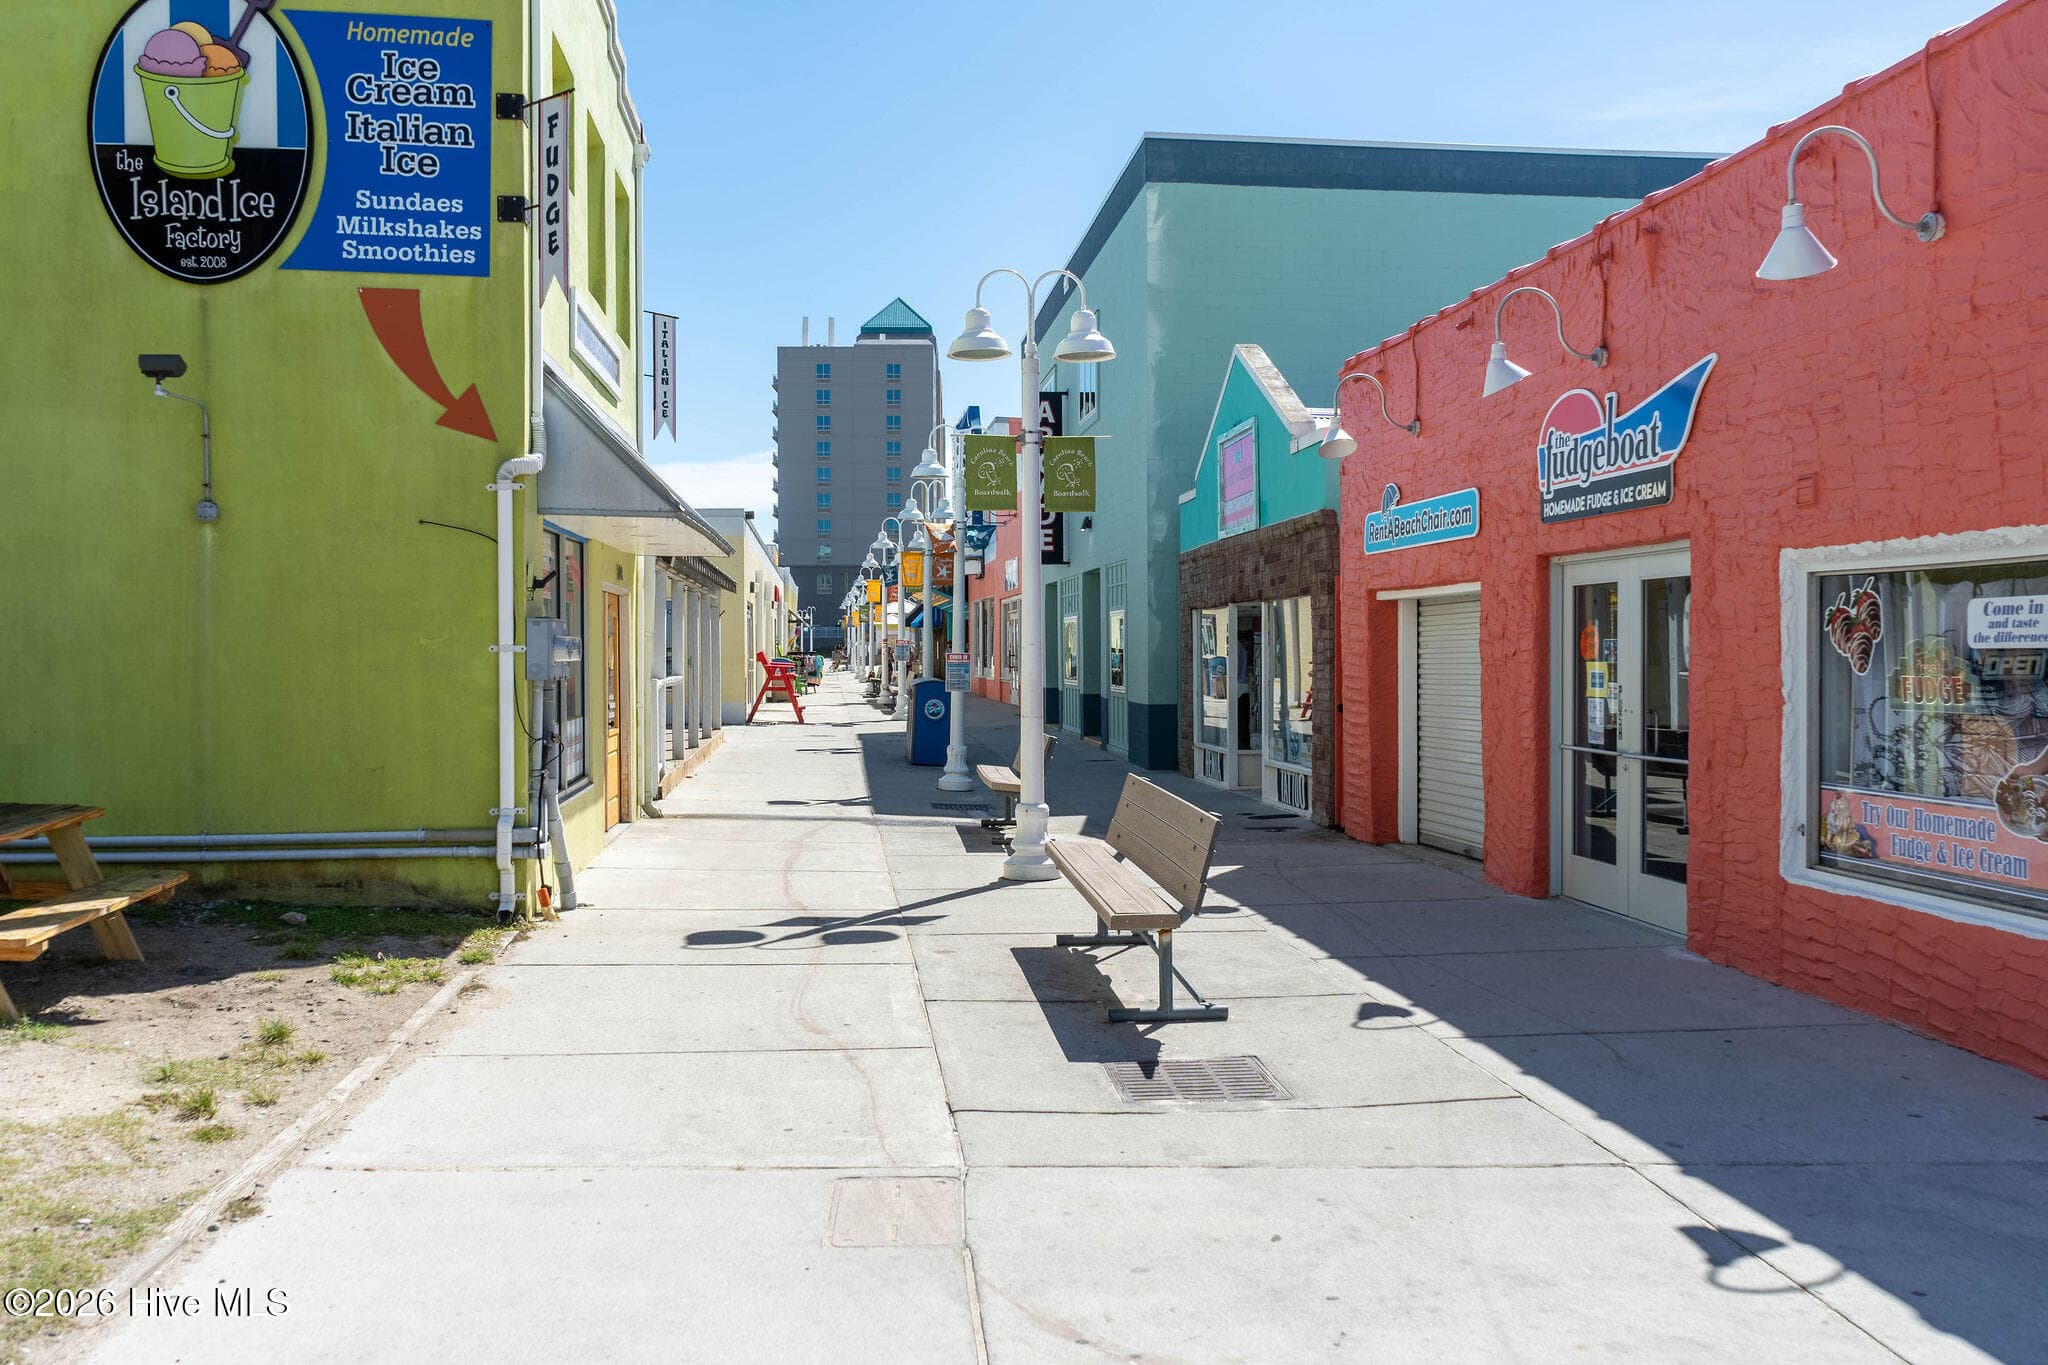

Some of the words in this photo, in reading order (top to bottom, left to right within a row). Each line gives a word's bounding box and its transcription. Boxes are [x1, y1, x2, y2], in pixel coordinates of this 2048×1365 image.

[347, 21, 475, 48] Homemade
[381, 50, 440, 82] Ice
[346, 73, 476, 109] Cream
[345, 111, 475, 148] Italian
[115, 150, 144, 172] the
[380, 144, 440, 178] Ice
[545, 112, 559, 256] FUDGE
[130, 176, 227, 222] Island
[229, 178, 276, 223] Ice
[355, 189, 464, 213] Sundaes
[165, 222, 242, 254] Factory
[336, 214, 482, 241] Milkshakes
[200, 256, 227, 268] 2008
[342, 239, 476, 264] Smoothies
[661, 321, 670, 386] ITALIAN
[661, 390, 669, 418] ICE
[1544, 397, 1661, 496] fudgeboat
[1555, 430, 1571, 449] the
[970, 447, 997, 465] Carolina
[1049, 448, 1075, 466] Carolina
[974, 488, 1012, 496] Boardwalk
[1053, 489, 1090, 497] Boardwalk
[1543, 495, 1586, 518] HOMEMADE
[1586, 490, 1612, 510] FUDGE
[1613, 489, 1620, 506] &
[1620, 486, 1634, 503] ICE
[1635, 480, 1667, 500] CREAM
[1368, 505, 1473, 544] RentABeachChair.com
[1983, 601, 2024, 616] Come
[2028, 599, 2044, 615] in
[1988, 617, 2009, 629] and
[2012, 618, 2040, 629] taste
[1973, 632, 1991, 643] the
[1984, 656, 2043, 676] OPEN
[1900, 675, 1965, 706] FUDGE
[1861, 800, 1883, 829] Try
[1886, 804, 1910, 830] Our
[1913, 807, 1997, 843] Homemade
[1890, 833, 1932, 864] Fudge
[1936, 840, 1949, 864] &
[1951, 842, 1975, 870] Ice
[1978, 847, 2029, 880] Cream
